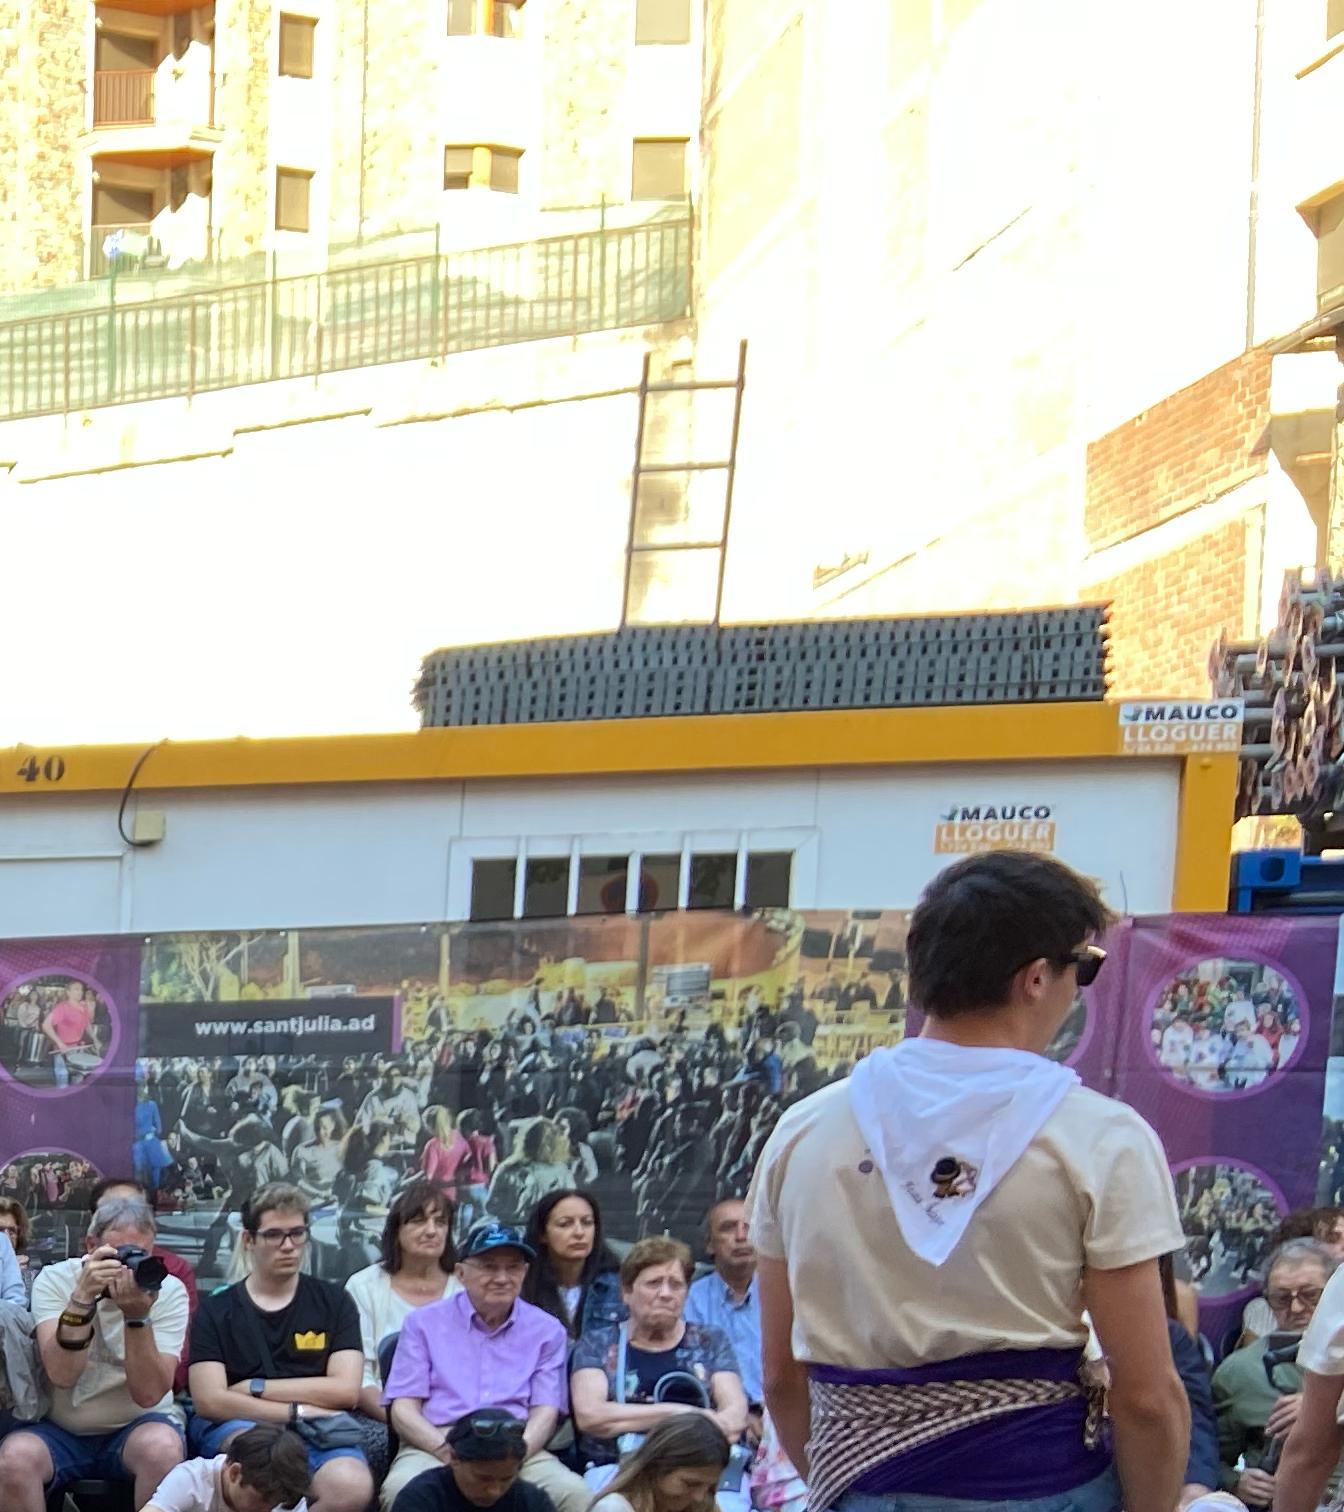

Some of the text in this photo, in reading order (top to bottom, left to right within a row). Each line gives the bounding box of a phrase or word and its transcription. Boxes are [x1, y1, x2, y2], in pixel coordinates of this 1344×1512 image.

[1144, 704, 1238, 721] MAUCO
[1123, 723, 1238, 743] LLOGUER
[16, 753, 65, 783] 40
[961, 805, 1051, 820] MAUCO
[941, 822, 1049, 842] LLOGUER
[194, 1014, 376, 1036] www.santjulia.ad
